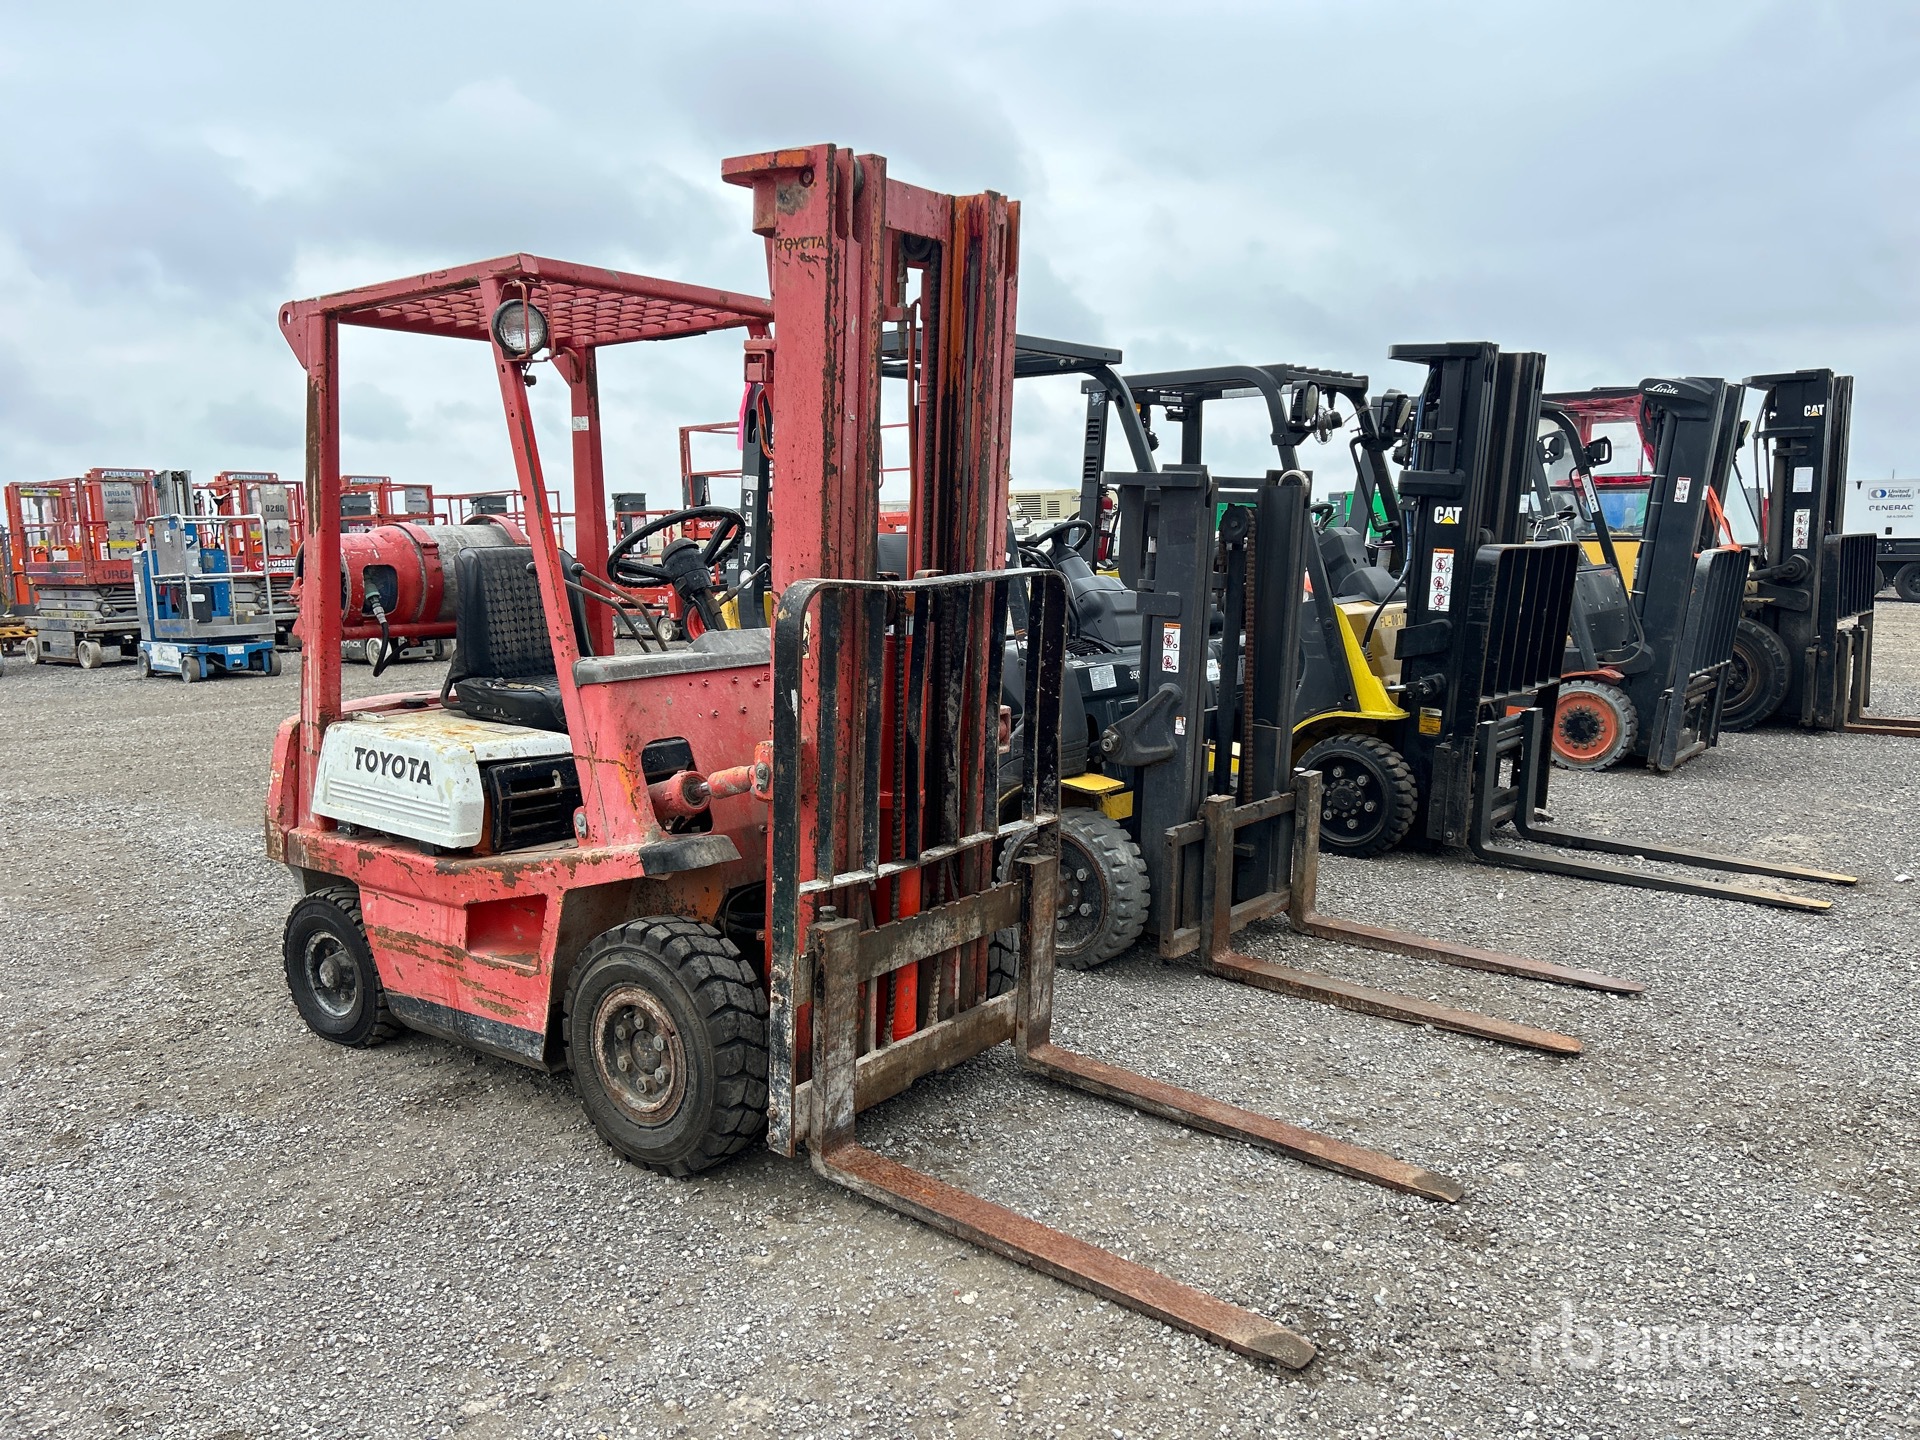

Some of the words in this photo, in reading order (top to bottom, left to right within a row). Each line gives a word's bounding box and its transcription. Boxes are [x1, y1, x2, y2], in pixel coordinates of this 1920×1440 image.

[776, 236, 826, 252] TOYOTA
[1645, 382, 1679, 395] Linde
[1804, 404, 1825, 416] CAT
[104, 489, 131, 498] URBAN
[1433, 505, 1463, 525] CAT
[699, 520, 721, 529] SKYJA
[102, 569, 134, 580] URB
[354, 746, 433, 786] TOYOTA
